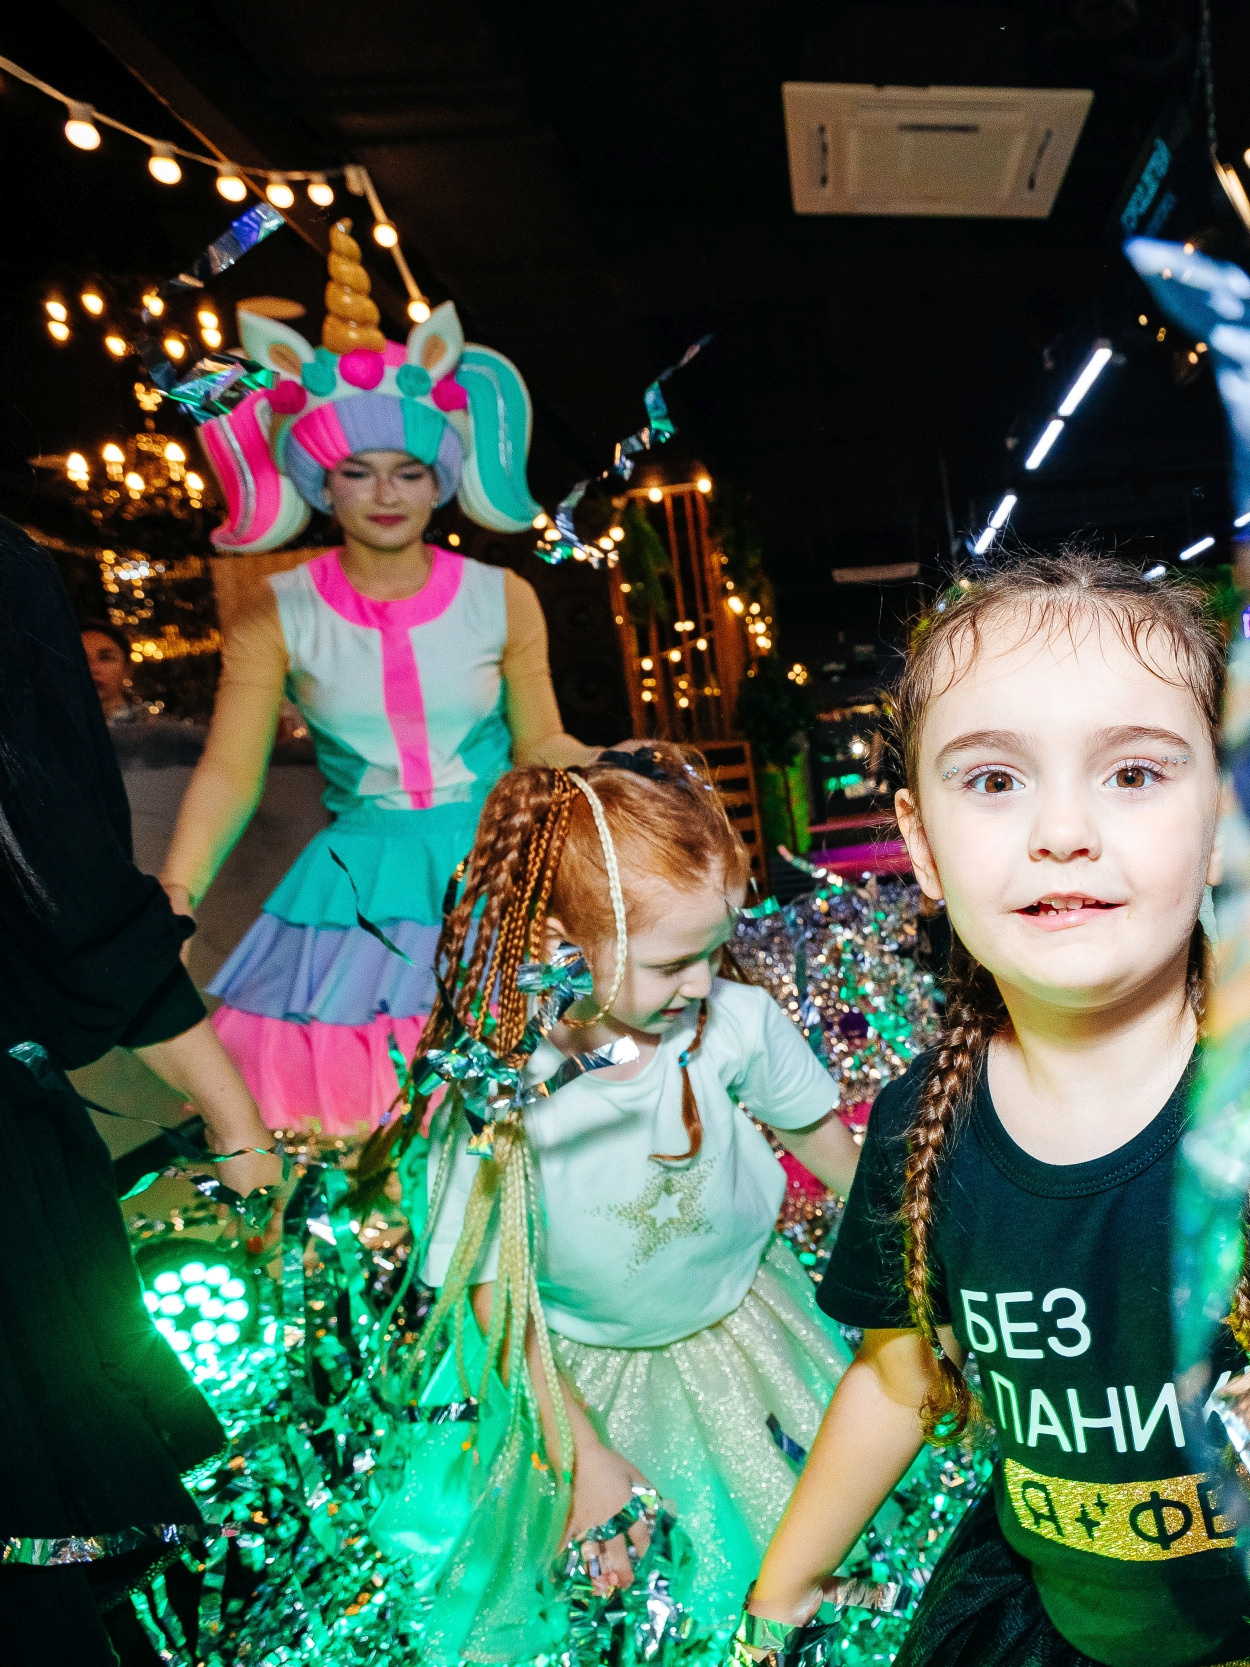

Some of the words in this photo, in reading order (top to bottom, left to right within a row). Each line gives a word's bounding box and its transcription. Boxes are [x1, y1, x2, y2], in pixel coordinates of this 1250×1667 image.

[960, 1287, 1092, 1359] БЕЗ
[1021, 1479, 1063, 1538] Я
[1128, 1480, 1238, 1550] ФЕ
